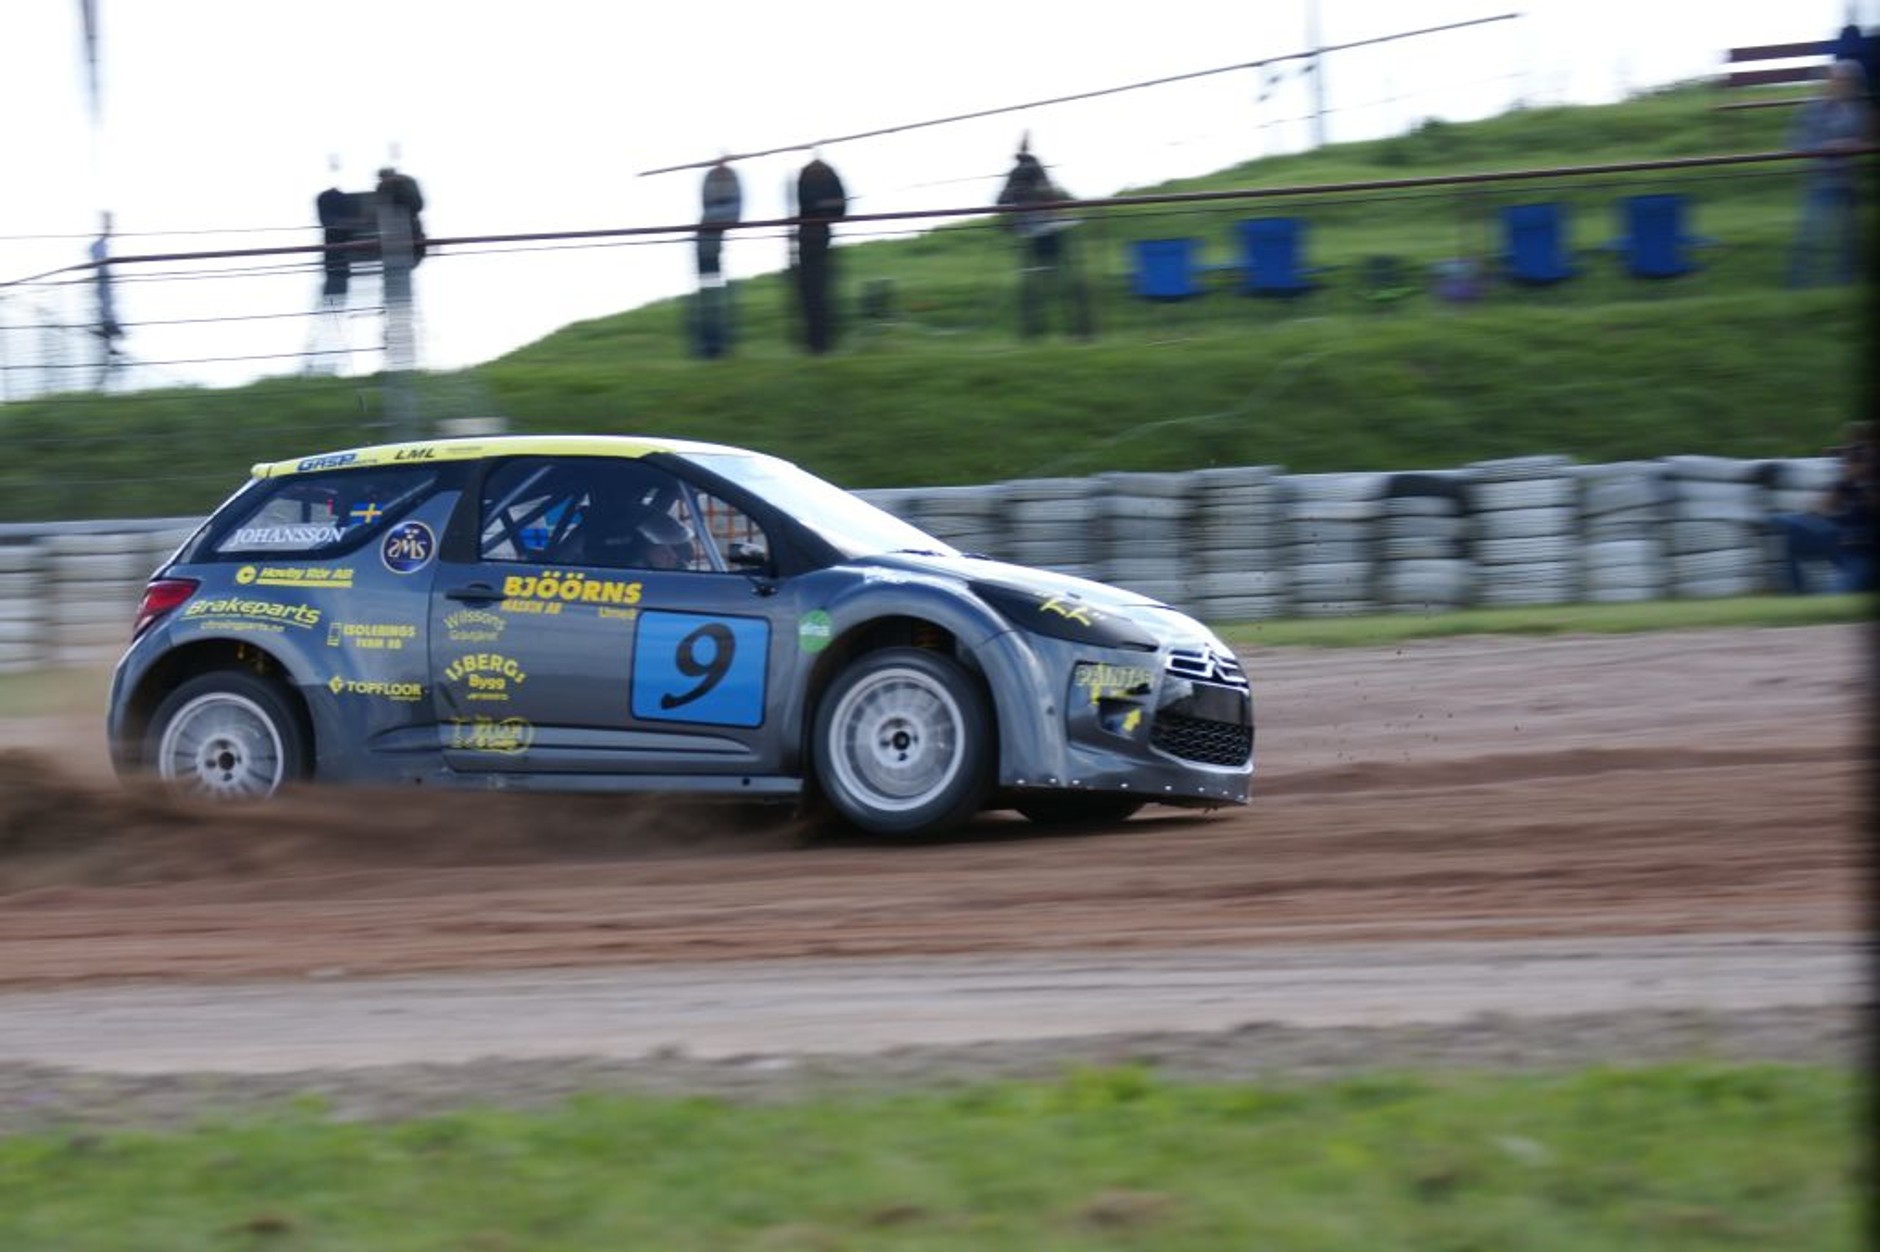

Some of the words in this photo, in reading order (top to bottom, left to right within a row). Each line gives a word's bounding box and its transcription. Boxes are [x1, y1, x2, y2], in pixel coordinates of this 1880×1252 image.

[231, 526, 347, 547] JOHANSSON
[502, 570, 643, 604] BJÖÖRNS
[185, 597, 321, 624] Brakeparts
[661, 622, 736, 710] 9
[347, 681, 422, 695] TOPFLOOR
